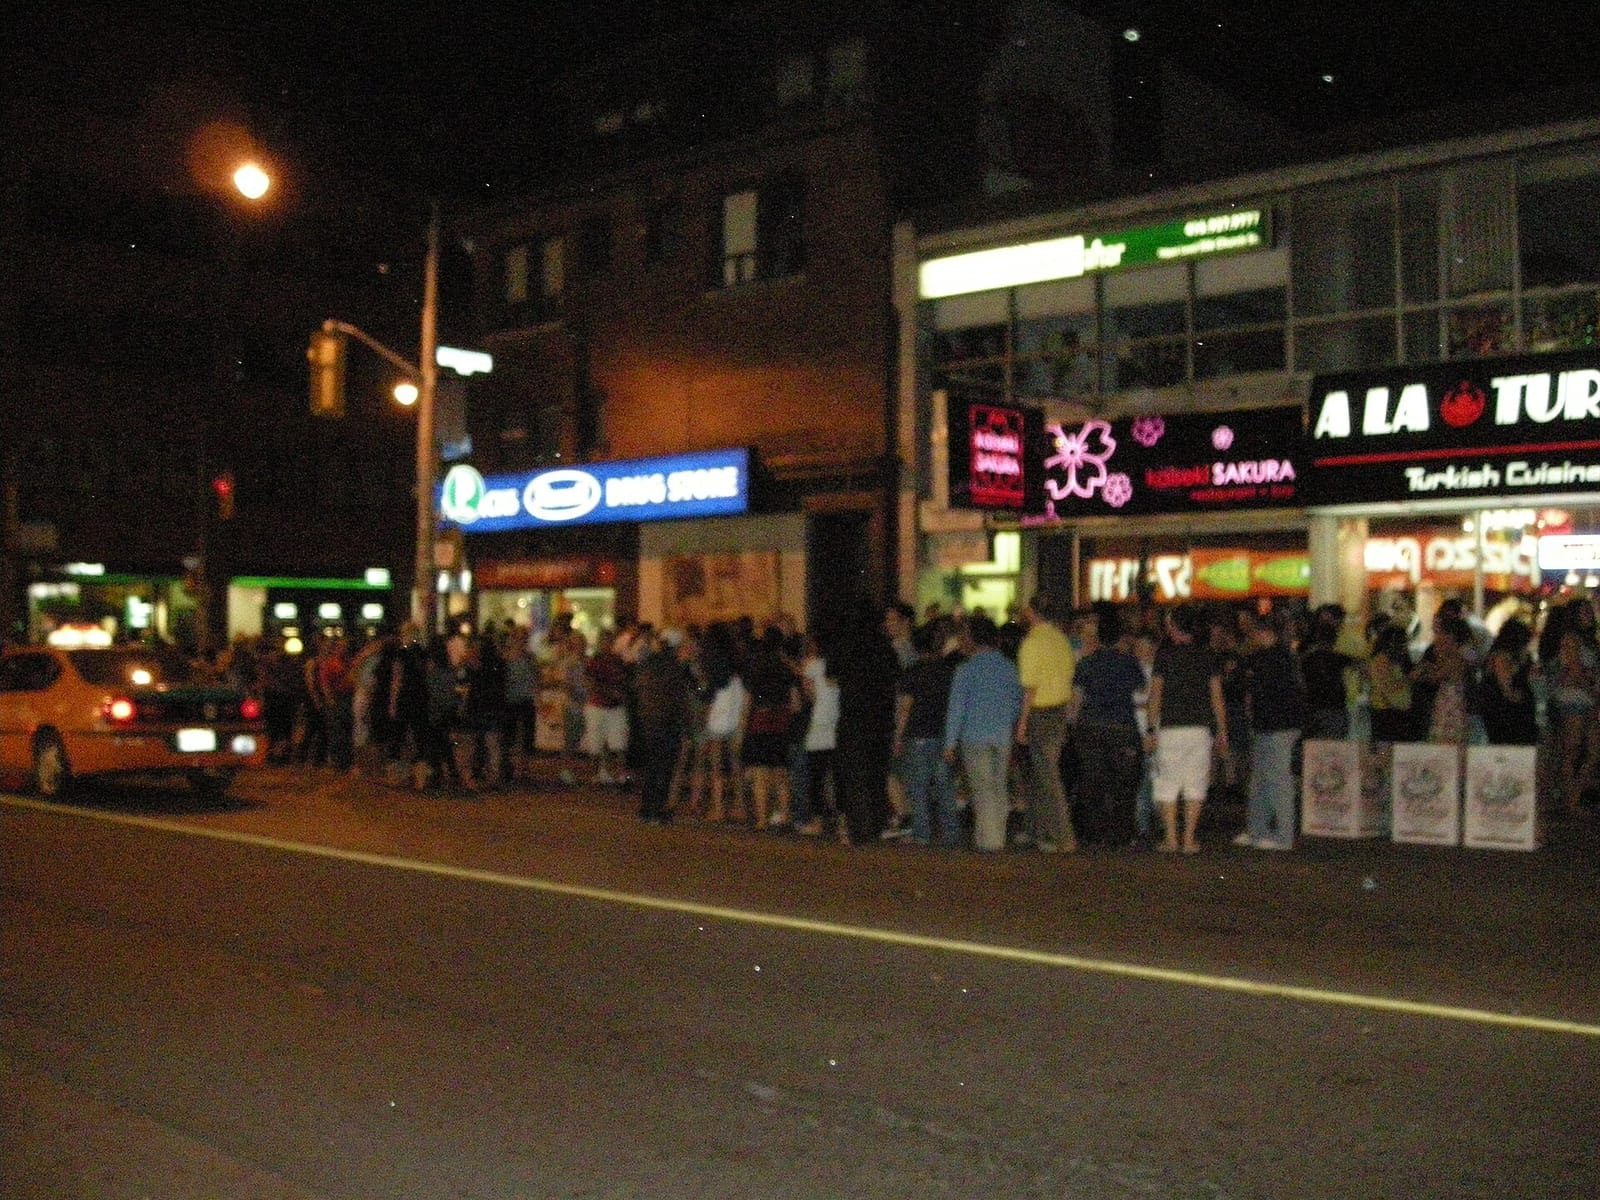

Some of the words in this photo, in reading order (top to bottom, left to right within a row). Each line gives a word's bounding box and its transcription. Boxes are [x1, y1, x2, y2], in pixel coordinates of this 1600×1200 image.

[1314, 390, 1351, 440] A
[1362, 384, 1430, 437] LA
[1211, 459, 1297, 487] SAKURA
[1404, 462, 1500, 492] Turkish
